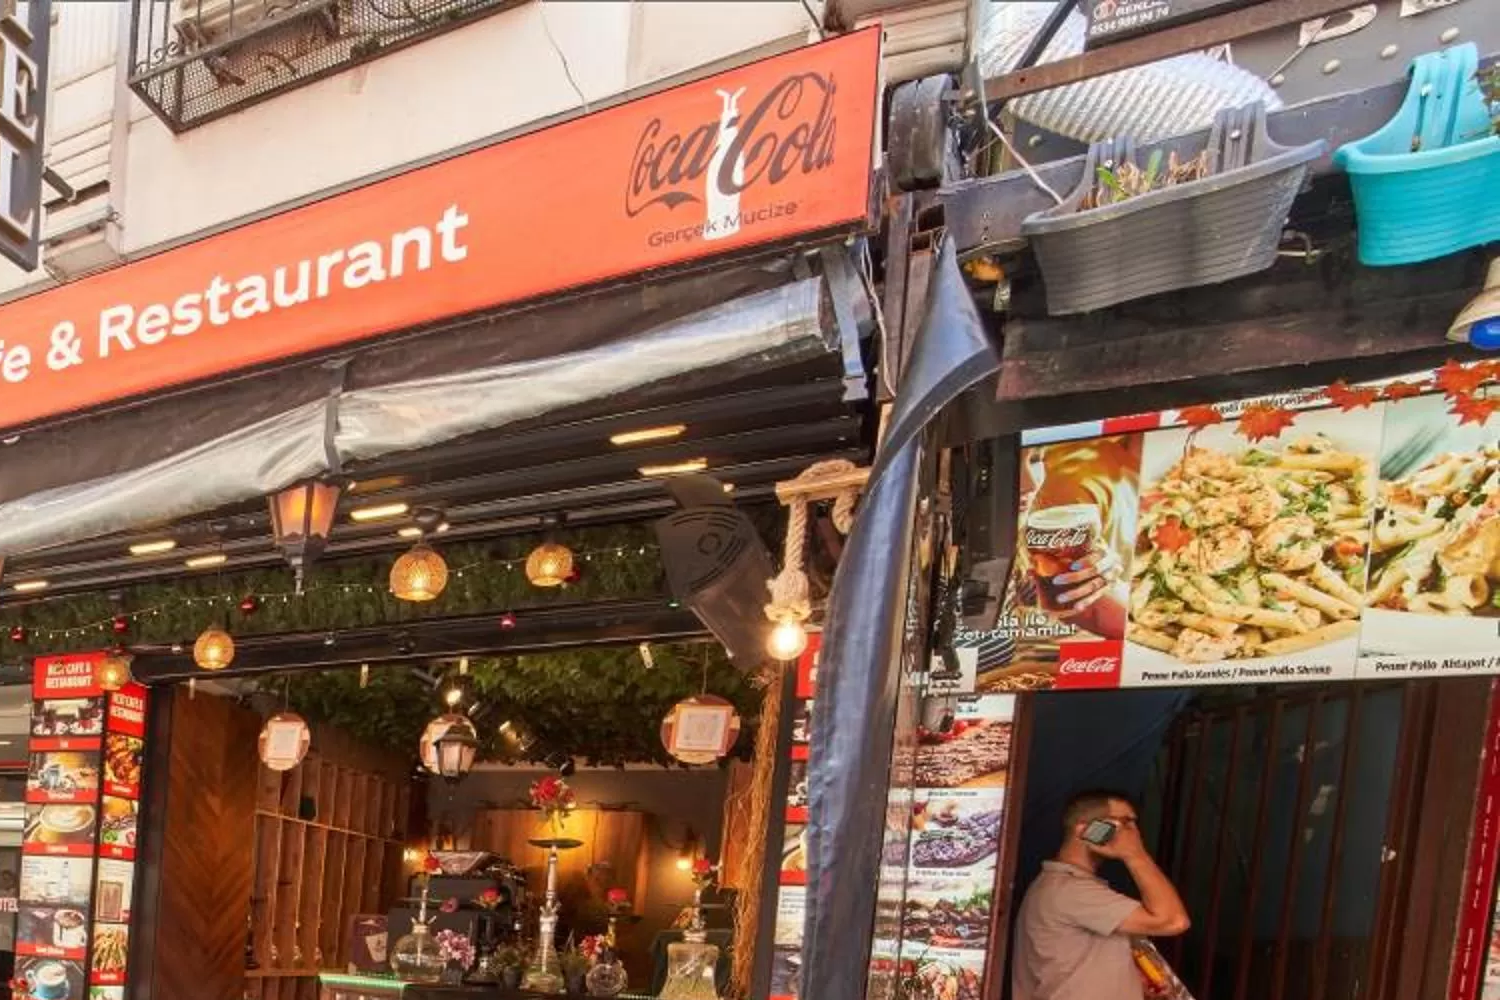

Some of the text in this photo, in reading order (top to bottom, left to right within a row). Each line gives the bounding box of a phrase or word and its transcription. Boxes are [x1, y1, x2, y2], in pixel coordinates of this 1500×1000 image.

[647, 202, 799, 248] Gerçek Mucize
[46, 319, 83, 371] &
[98, 203, 470, 358] Restaurant
[991, 622, 1077, 640] tamamla!
[1375, 661, 1408, 672] Penne
